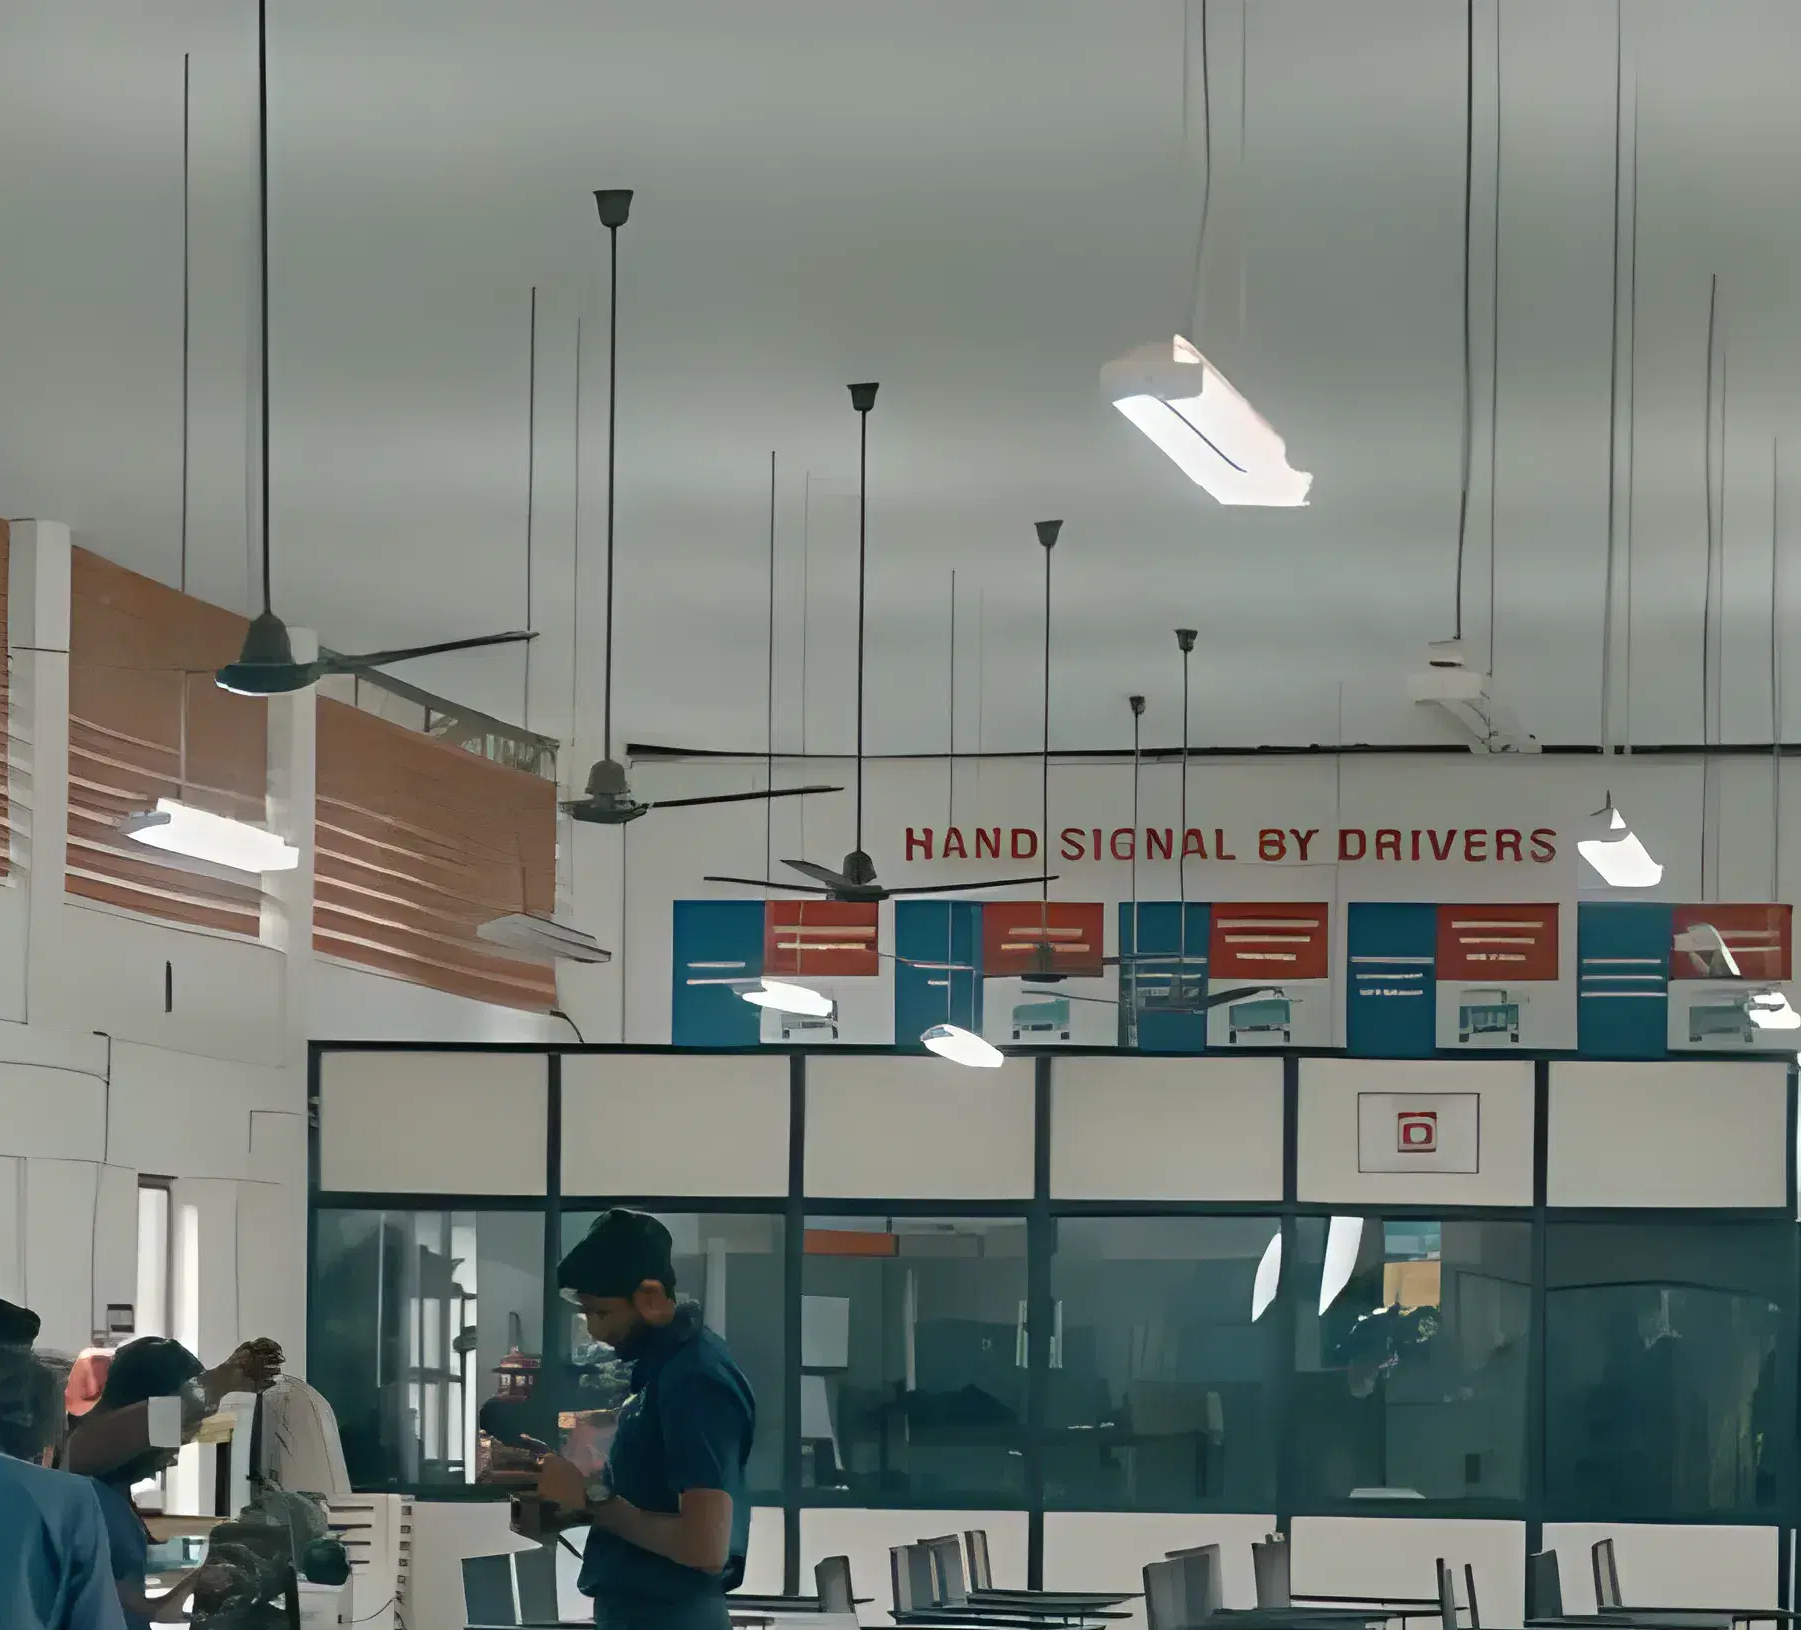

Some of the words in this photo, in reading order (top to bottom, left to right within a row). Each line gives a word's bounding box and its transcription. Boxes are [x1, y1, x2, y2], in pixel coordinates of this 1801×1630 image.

[904, 827, 1039, 862] HAND
[1059, 827, 1237, 862] SIGNAL
[1258, 828, 1320, 862] BY
[1337, 827, 1558, 863] DRIVERS
